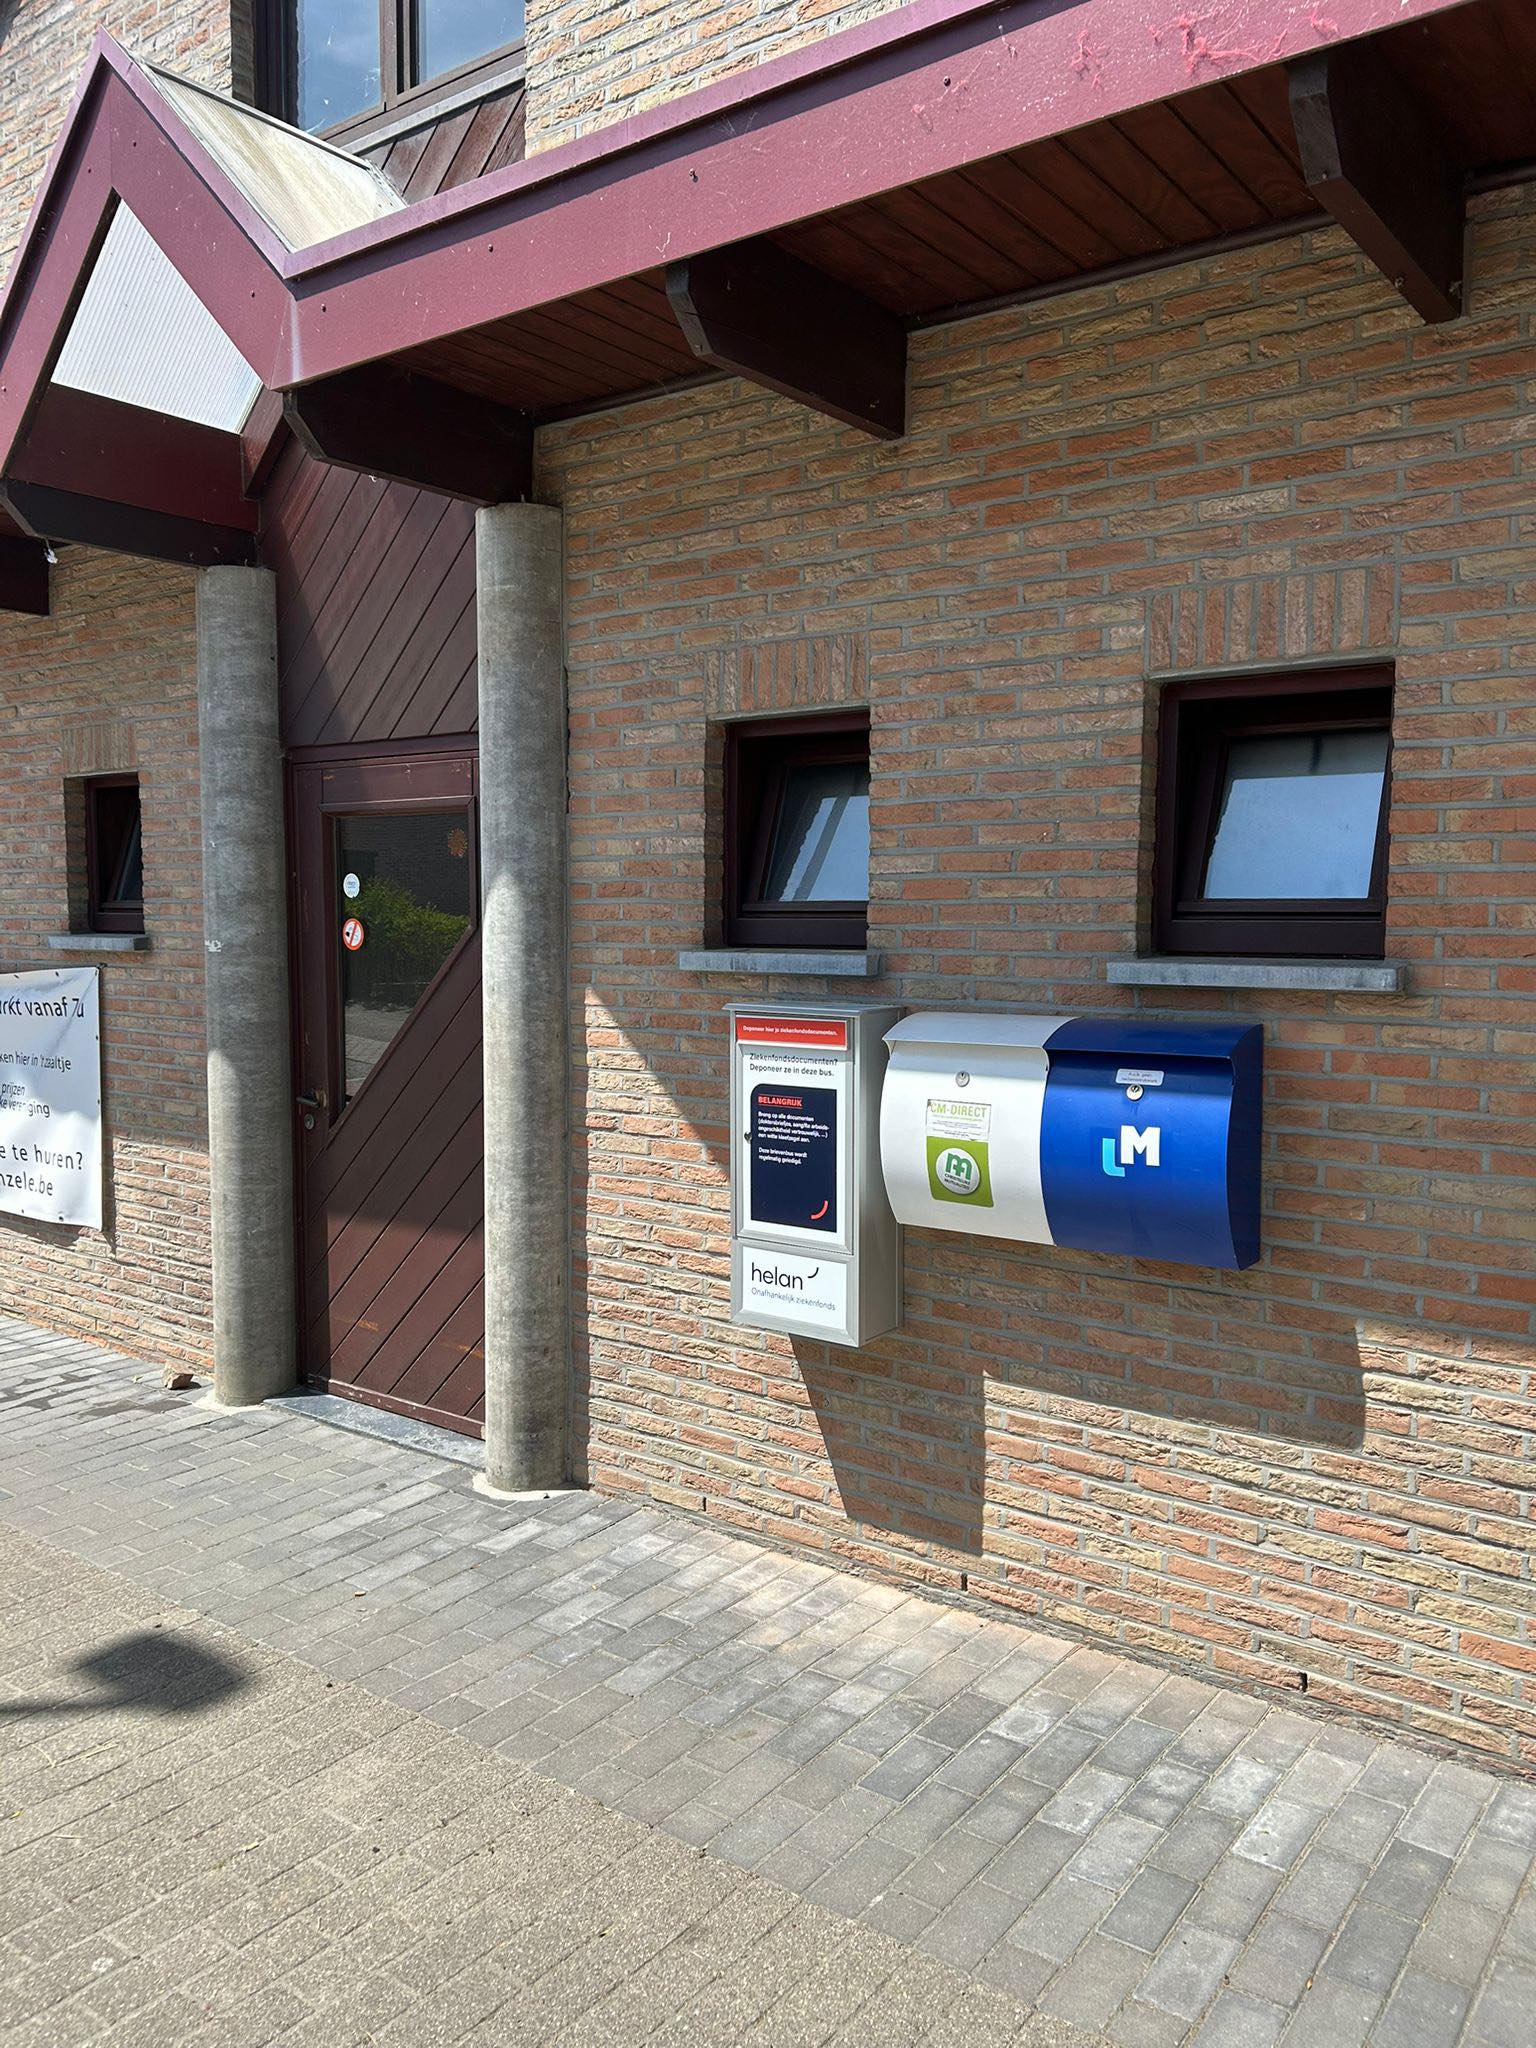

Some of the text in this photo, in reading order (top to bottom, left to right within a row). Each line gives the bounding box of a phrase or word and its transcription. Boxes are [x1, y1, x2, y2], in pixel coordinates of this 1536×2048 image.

[0, 996, 84, 1018] rkt vanaf 7u
[15, 1051, 30, 1065] hier
[31, 1053, 38, 1067] in
[750, 1053, 838, 1066] Ziekenfondsdocumenten?
[750, 1064, 782, 1072] Deponeer
[2, 1082, 25, 1097] prijzen
[9, 1100, 50, 1118] vereging
[758, 1096, 802, 1106] BELANGRIJK
[931, 1103, 987, 1117] CM-DIRECT
[12, 1144, 28, 1161] te
[34, 1144, 82, 1170] huren?
[1103, 1125, 1160, 1177] LM
[752, 1262, 802, 1290] helan
[752, 1287, 836, 1310] Onafhankelijk ziekenfonds
